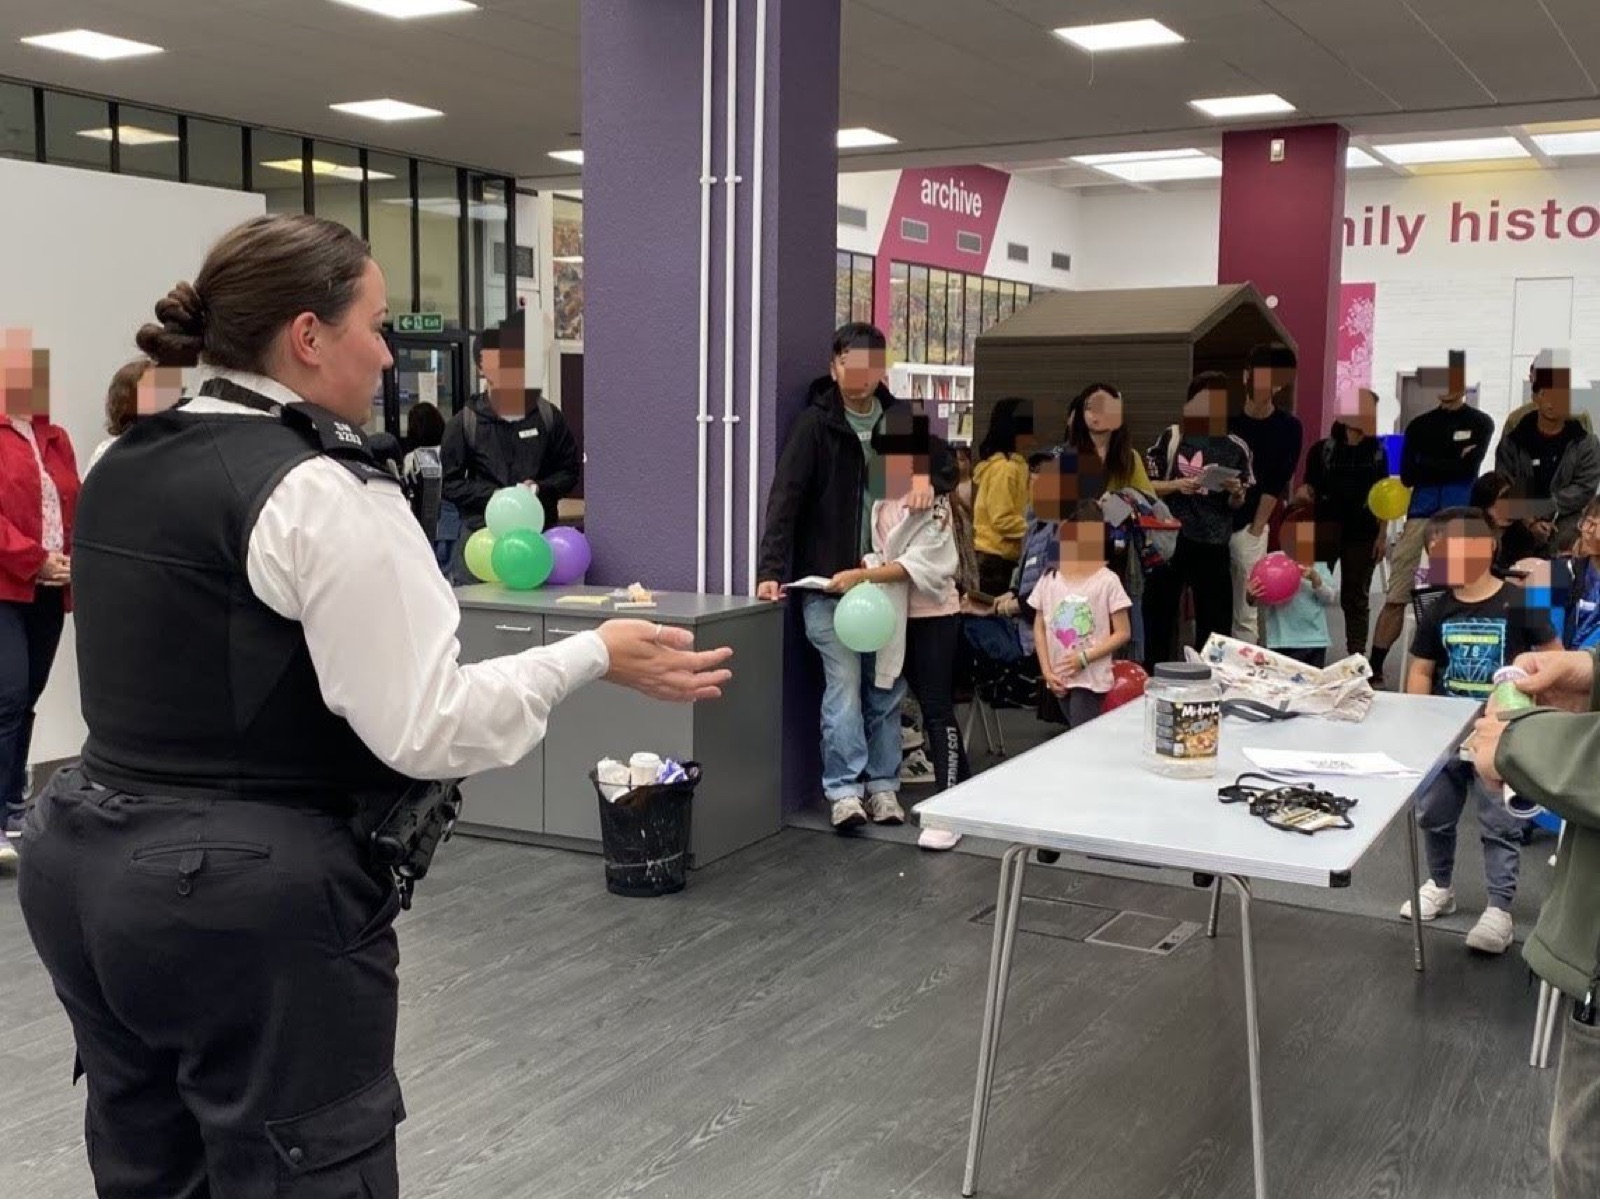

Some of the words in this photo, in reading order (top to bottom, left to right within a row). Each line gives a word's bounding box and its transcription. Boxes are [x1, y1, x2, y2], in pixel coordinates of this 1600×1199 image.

[921, 177, 982, 218] archive
[1343, 204, 1427, 254] ily
[1450, 199, 1600, 243] histo
[946, 726, 958, 749] LOS
